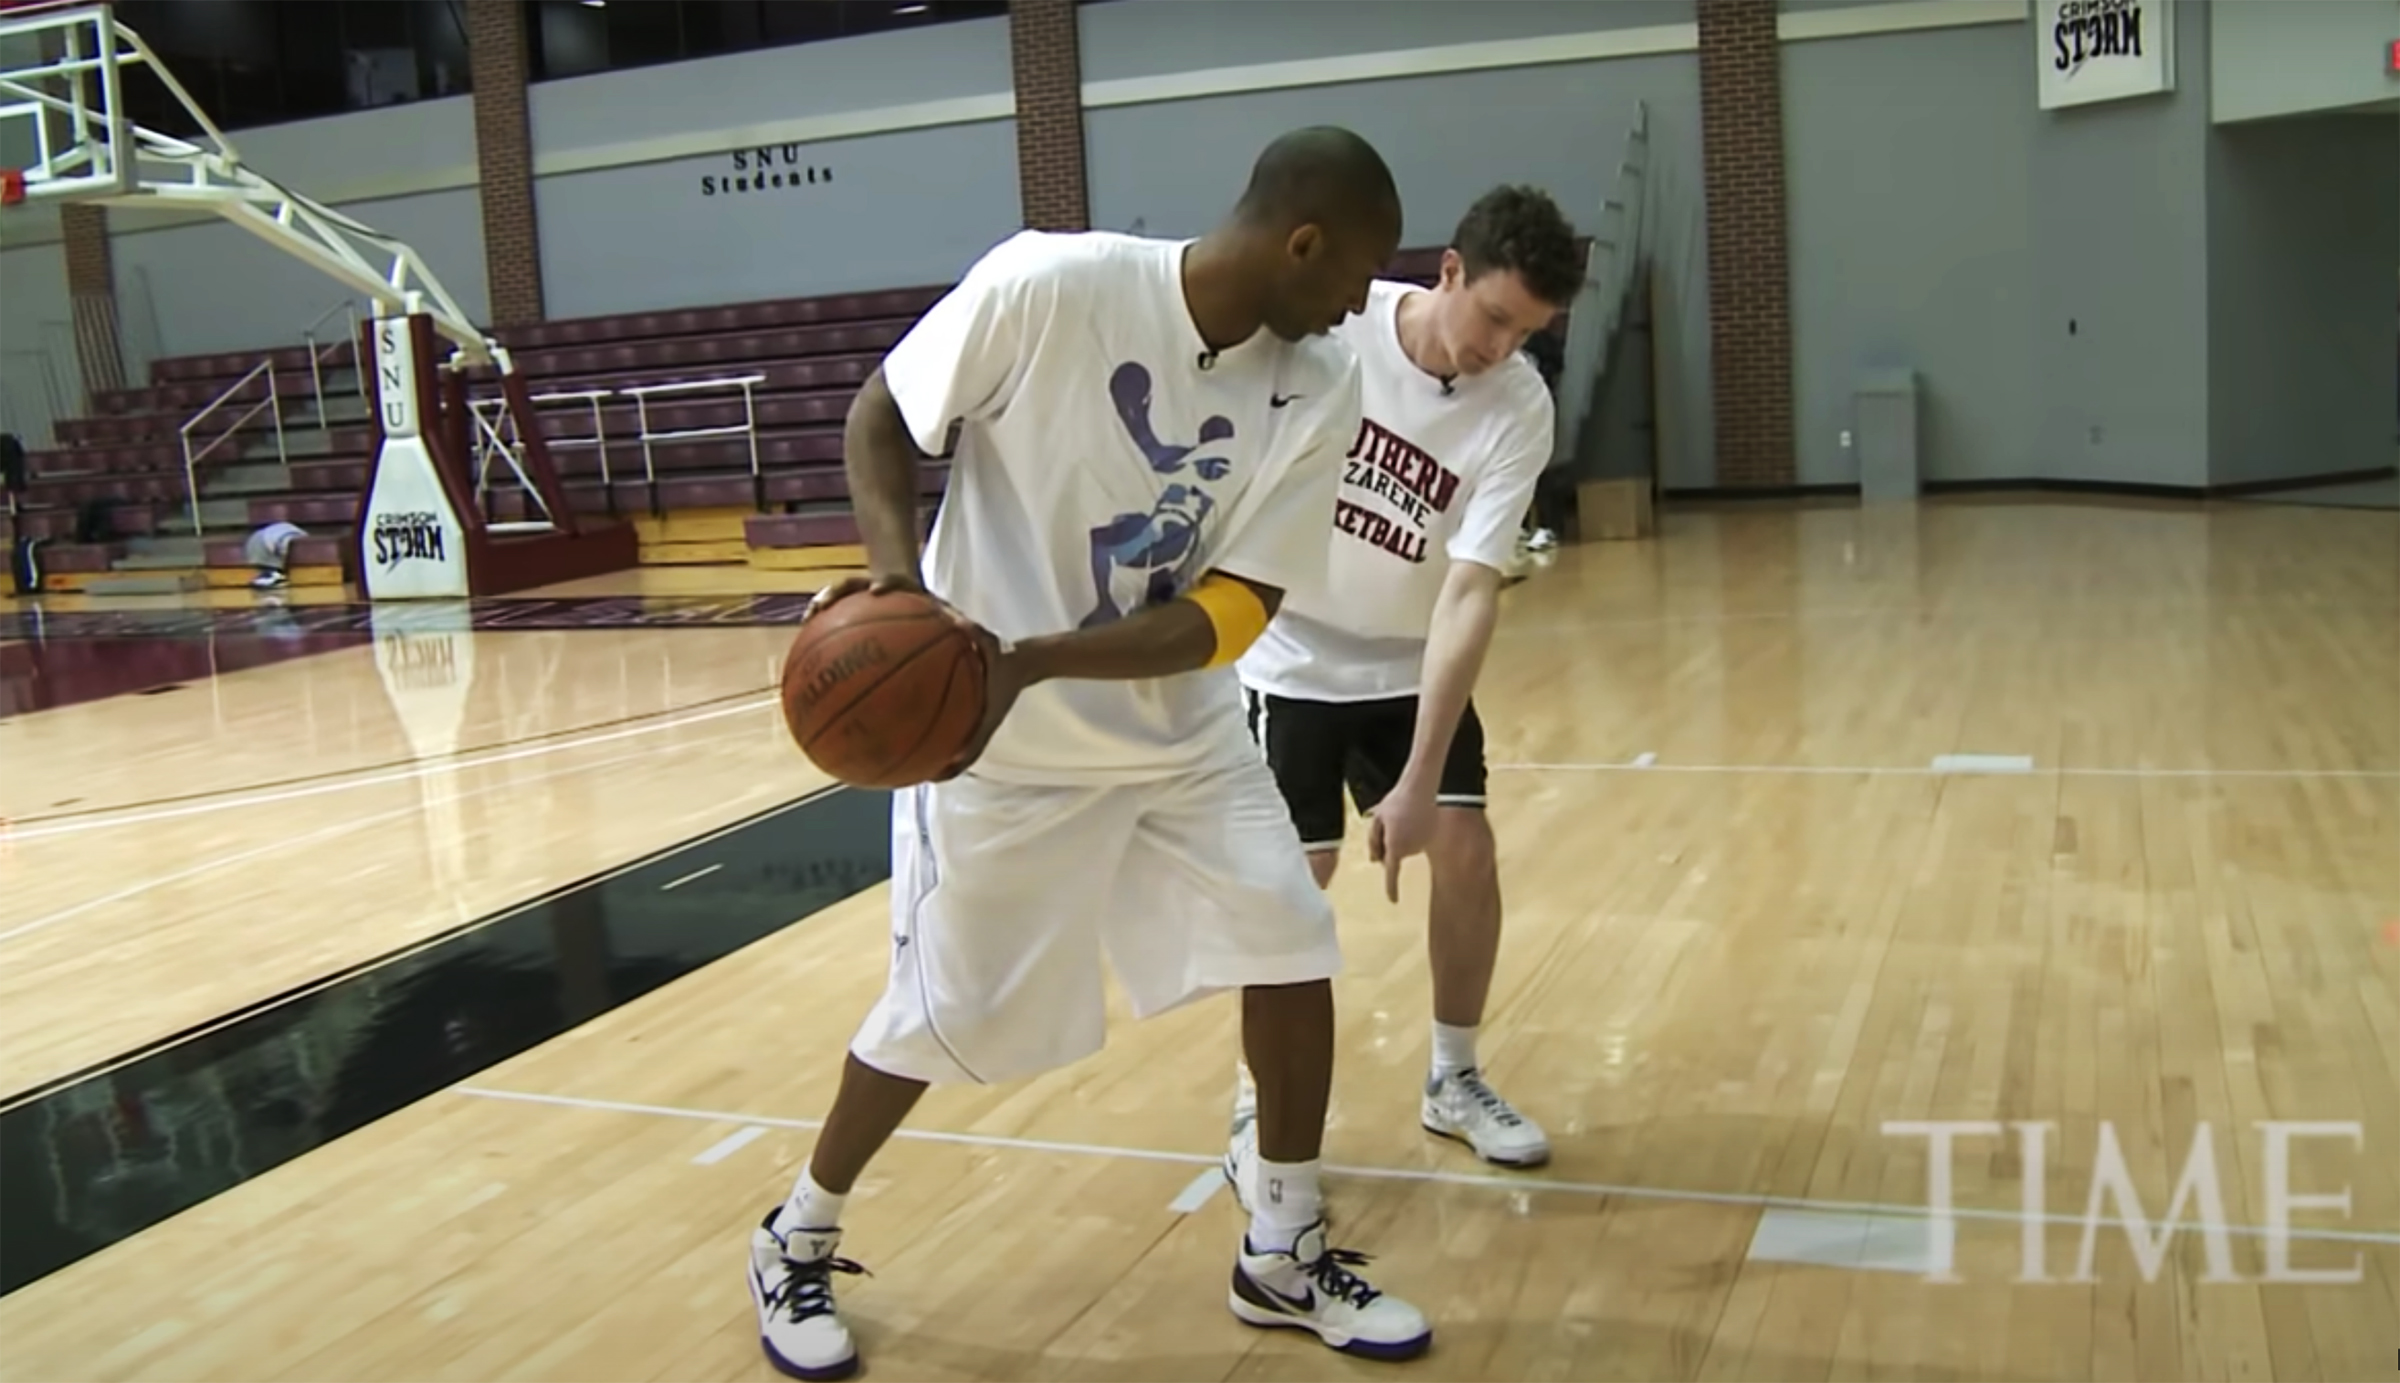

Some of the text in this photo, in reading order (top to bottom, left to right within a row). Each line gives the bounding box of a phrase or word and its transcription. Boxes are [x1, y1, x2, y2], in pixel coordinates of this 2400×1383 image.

[2058, 0, 2137, 19] CRIMSO
[2054, 7, 2142, 71] STORM
[732, 142, 798, 171] SNU
[701, 166, 833, 196] Students
[382, 329, 404, 428] SNU
[1343, 461, 1431, 529] ZARENE
[373, 524, 445, 566] STORM
